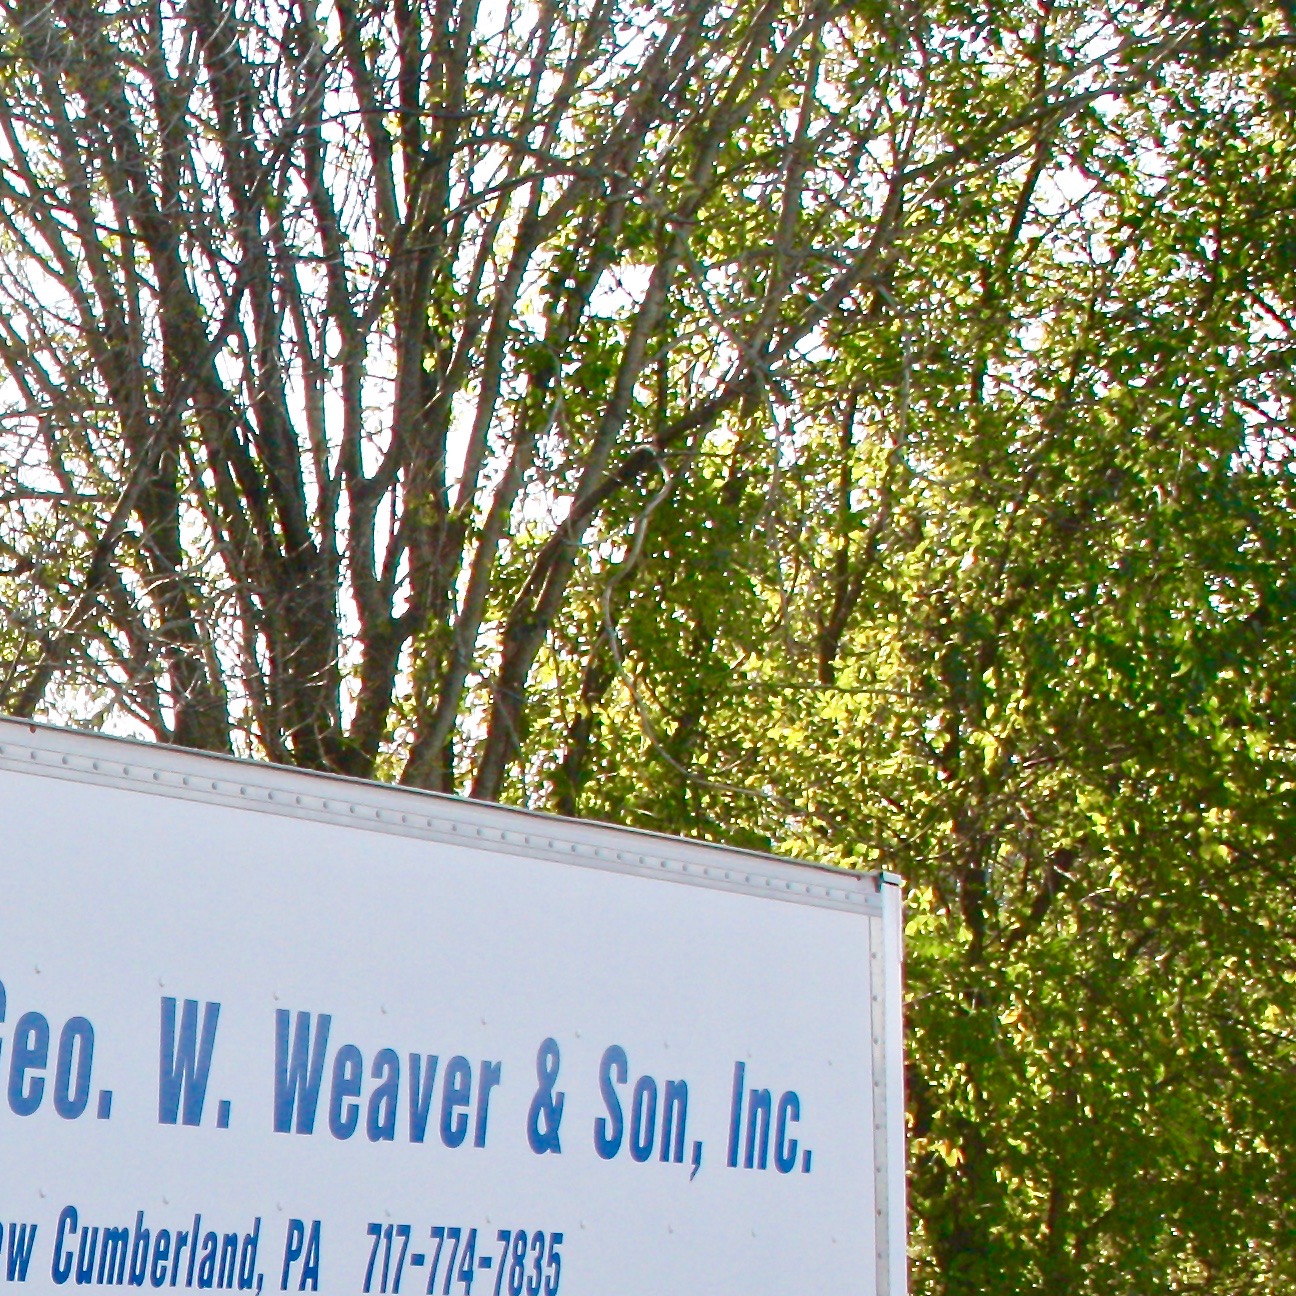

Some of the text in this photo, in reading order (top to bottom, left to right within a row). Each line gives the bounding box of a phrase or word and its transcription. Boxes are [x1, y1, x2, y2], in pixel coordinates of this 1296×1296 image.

[158, 996, 232, 1130] W.
[273, 1008, 502, 1149] Weaver
[526, 1037, 566, 1155] &
[593, 1044, 704, 1182] Son,
[726, 1060, 814, 1175] Inc.
[279, 1218, 322, 1293] PA
